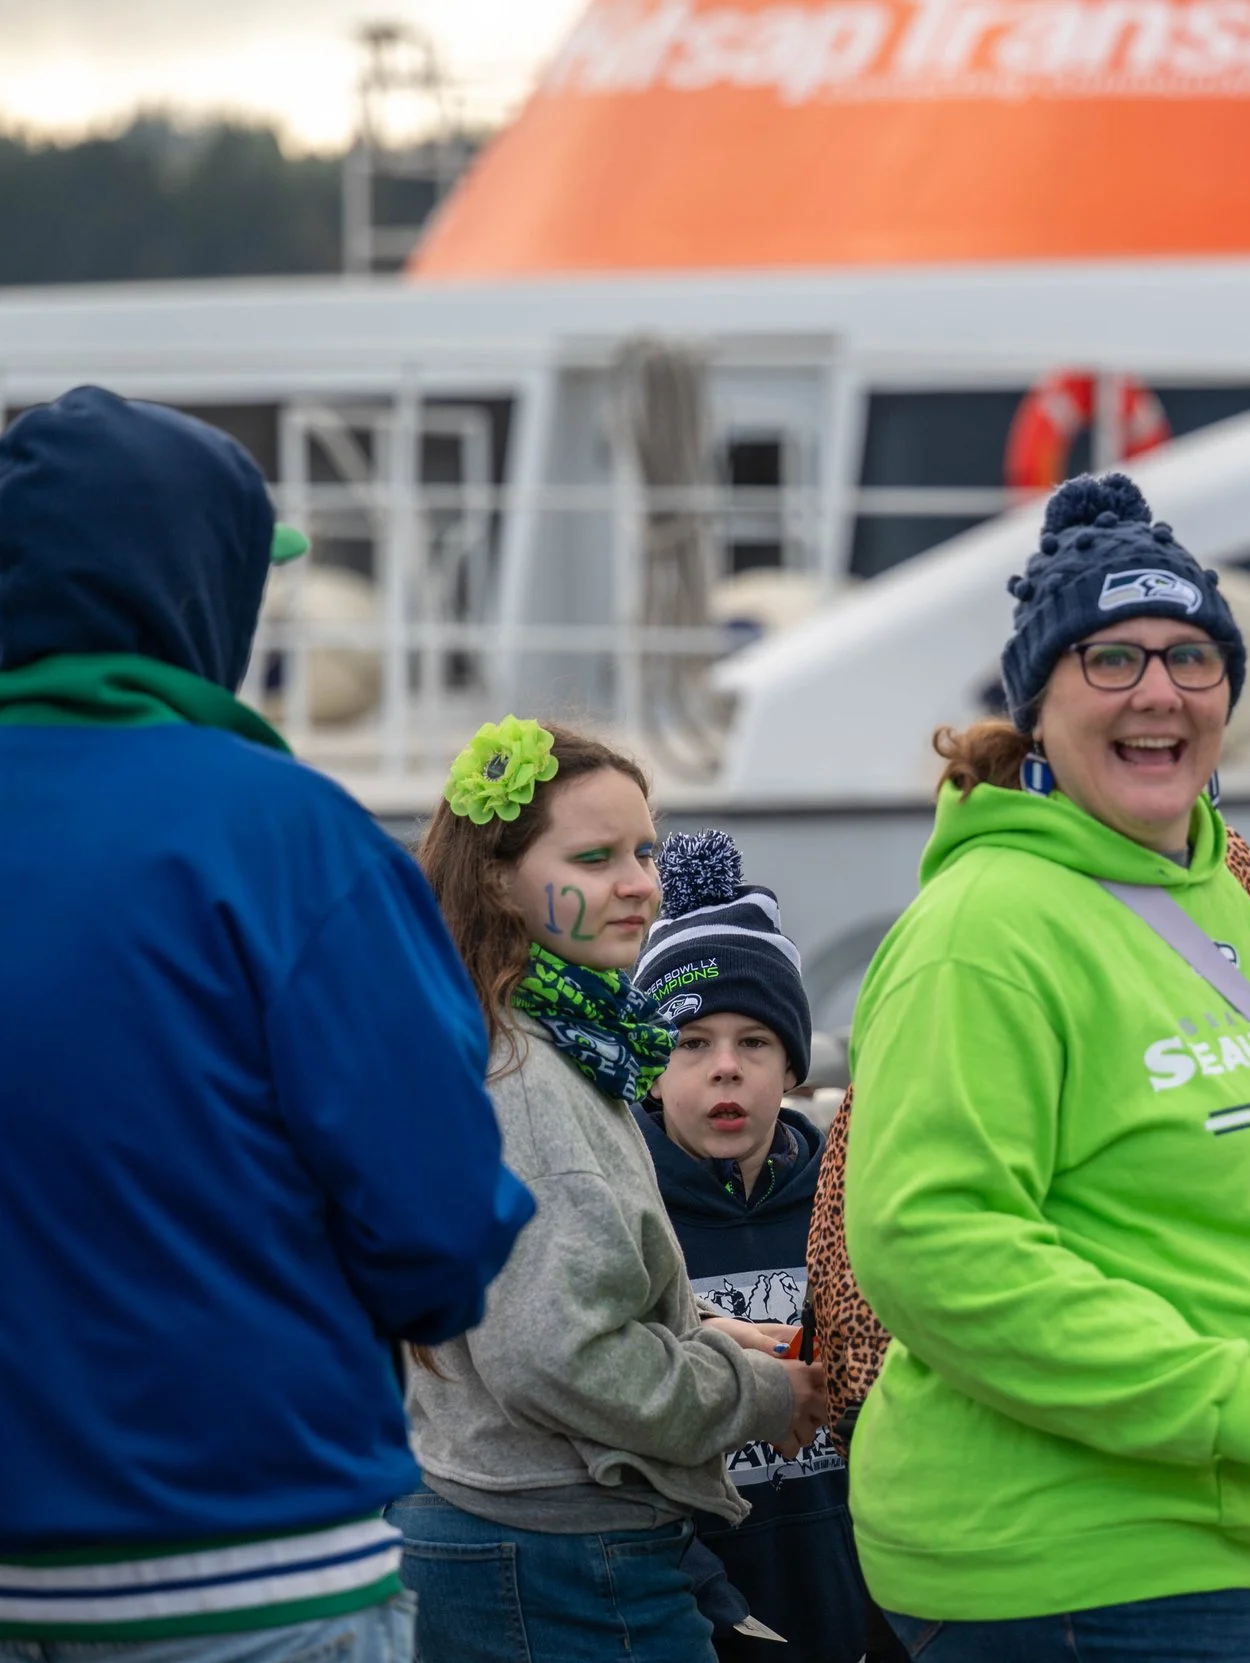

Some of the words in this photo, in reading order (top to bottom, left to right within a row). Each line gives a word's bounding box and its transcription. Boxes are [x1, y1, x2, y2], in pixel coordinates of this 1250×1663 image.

[544, 881, 595, 942] 12
[645, 978, 664, 996] PER
[664, 962, 699, 984] BOWL
[700, 957, 717, 969] LX
[652, 966, 720, 1001] AMPIONS
